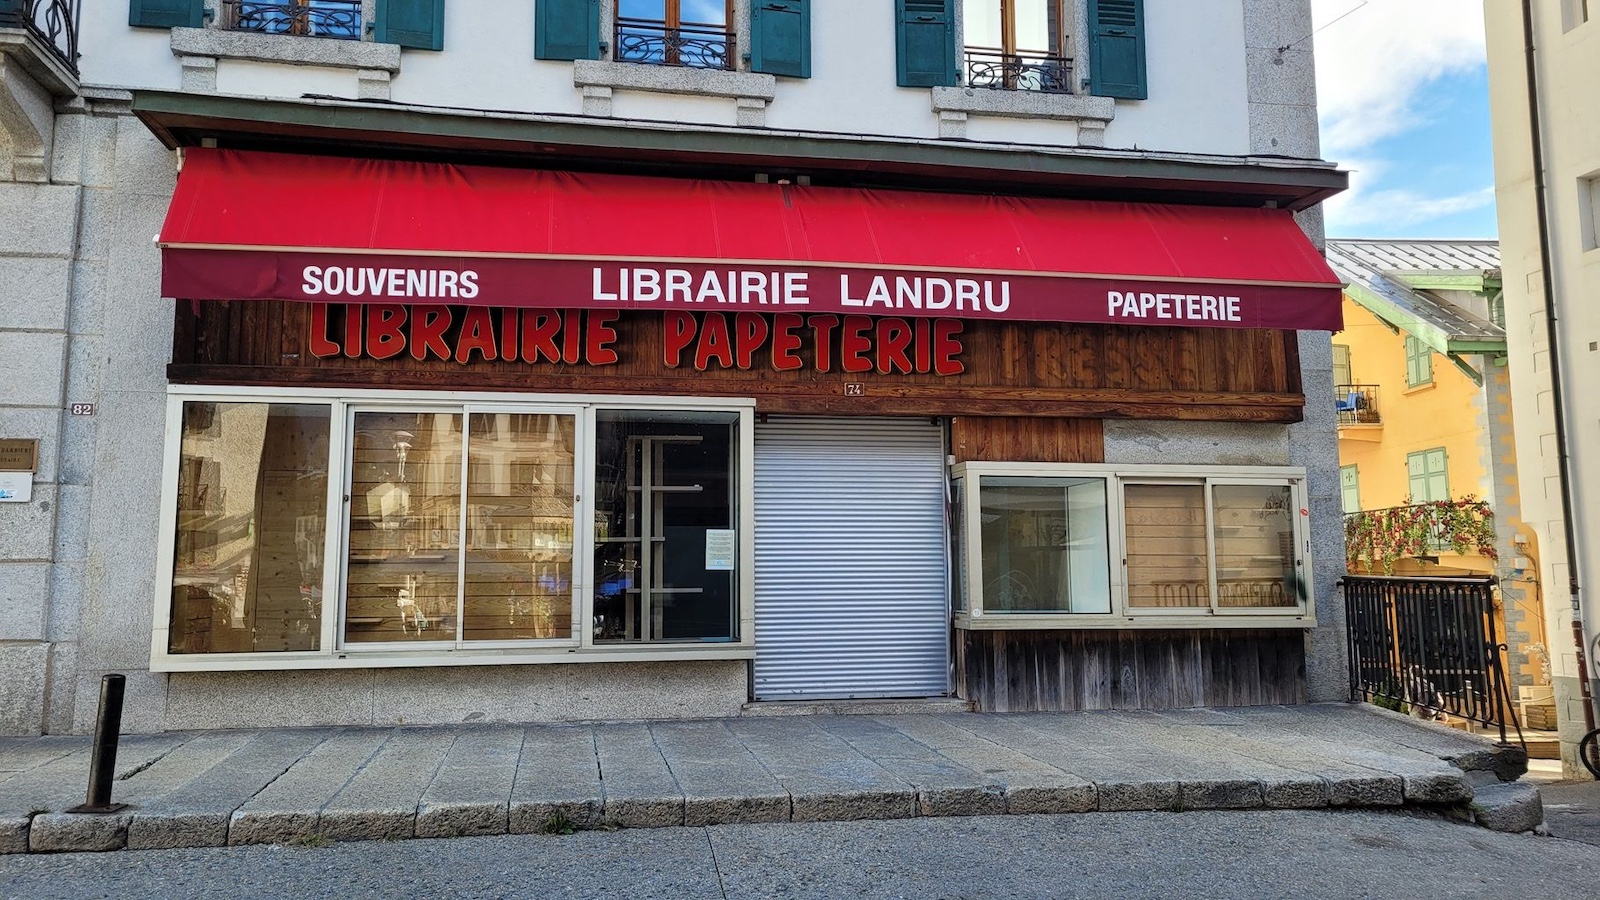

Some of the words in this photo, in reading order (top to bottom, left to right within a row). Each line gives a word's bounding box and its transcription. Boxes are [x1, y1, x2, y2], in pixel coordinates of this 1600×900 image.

[303, 266, 478, 298] SOUVENIRS
[593, 268, 809, 304] LIBRAIRIE
[841, 275, 1009, 312] LANDRU
[1108, 292, 1240, 321] PAPETERIE
[308, 302, 620, 366] LIBRAIRIE
[663, 311, 965, 376] PAPETERIE
[847, 384, 861, 395] 74
[73, 404, 92, 415] 82
